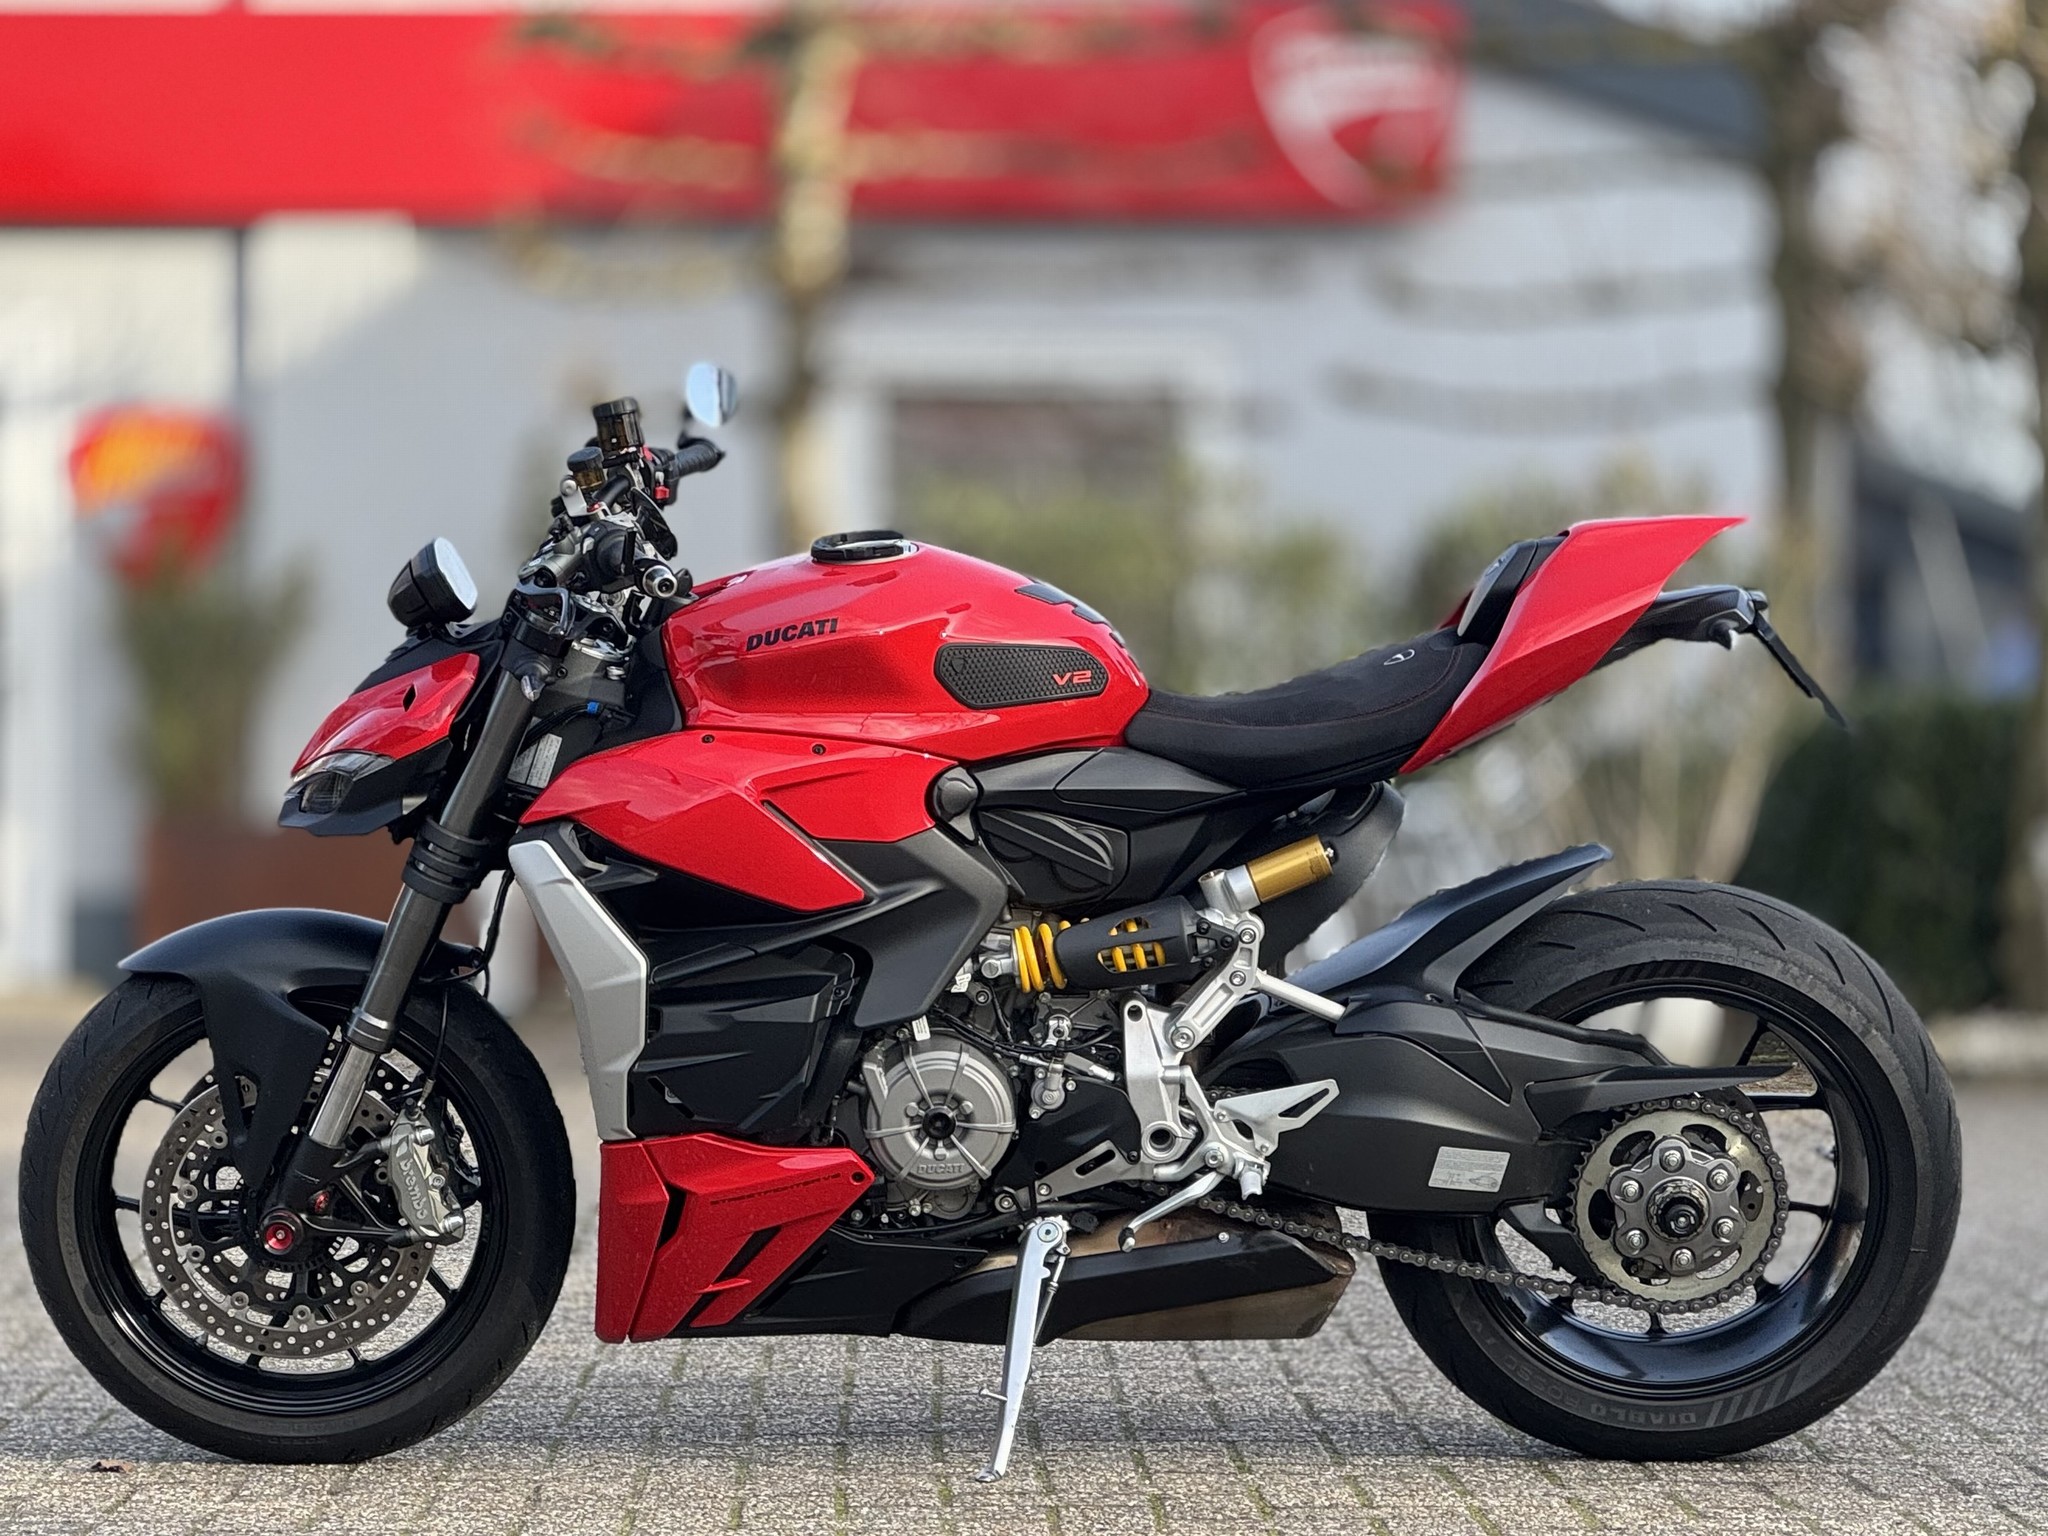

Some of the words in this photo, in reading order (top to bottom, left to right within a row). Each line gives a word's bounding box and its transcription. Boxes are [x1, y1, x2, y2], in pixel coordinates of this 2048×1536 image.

[745, 617, 839, 652] DUCATI
[1052, 670, 1092, 686] V2
[916, 1162, 966, 1175] DUCATI
[400, 1157, 428, 1220] brembo
[1590, 1402, 1697, 1425] DIABLO
